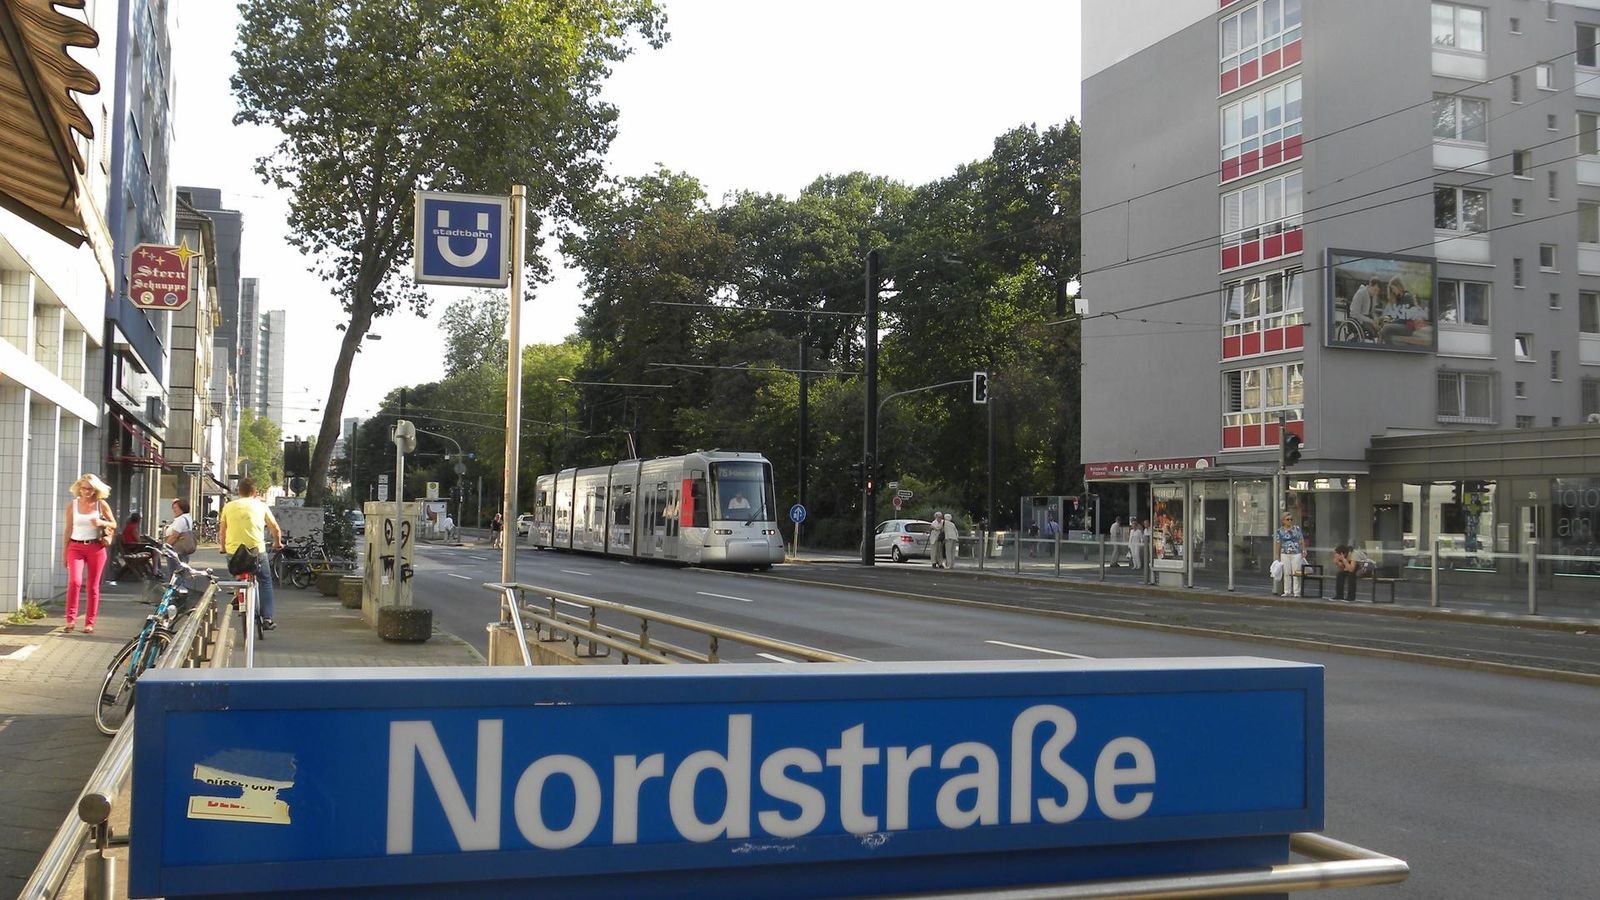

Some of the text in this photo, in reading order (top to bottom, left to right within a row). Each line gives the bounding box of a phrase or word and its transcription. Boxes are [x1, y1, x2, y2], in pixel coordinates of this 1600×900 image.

[432, 228, 493, 240] stadtbahn
[133, 265, 187, 280] Stern
[132, 279, 187, 292] Schnuppe
[1528, 491, 1537, 499] 35
[1556, 516, 1592, 538] am
[386, 704, 1156, 856] Nordstraße
